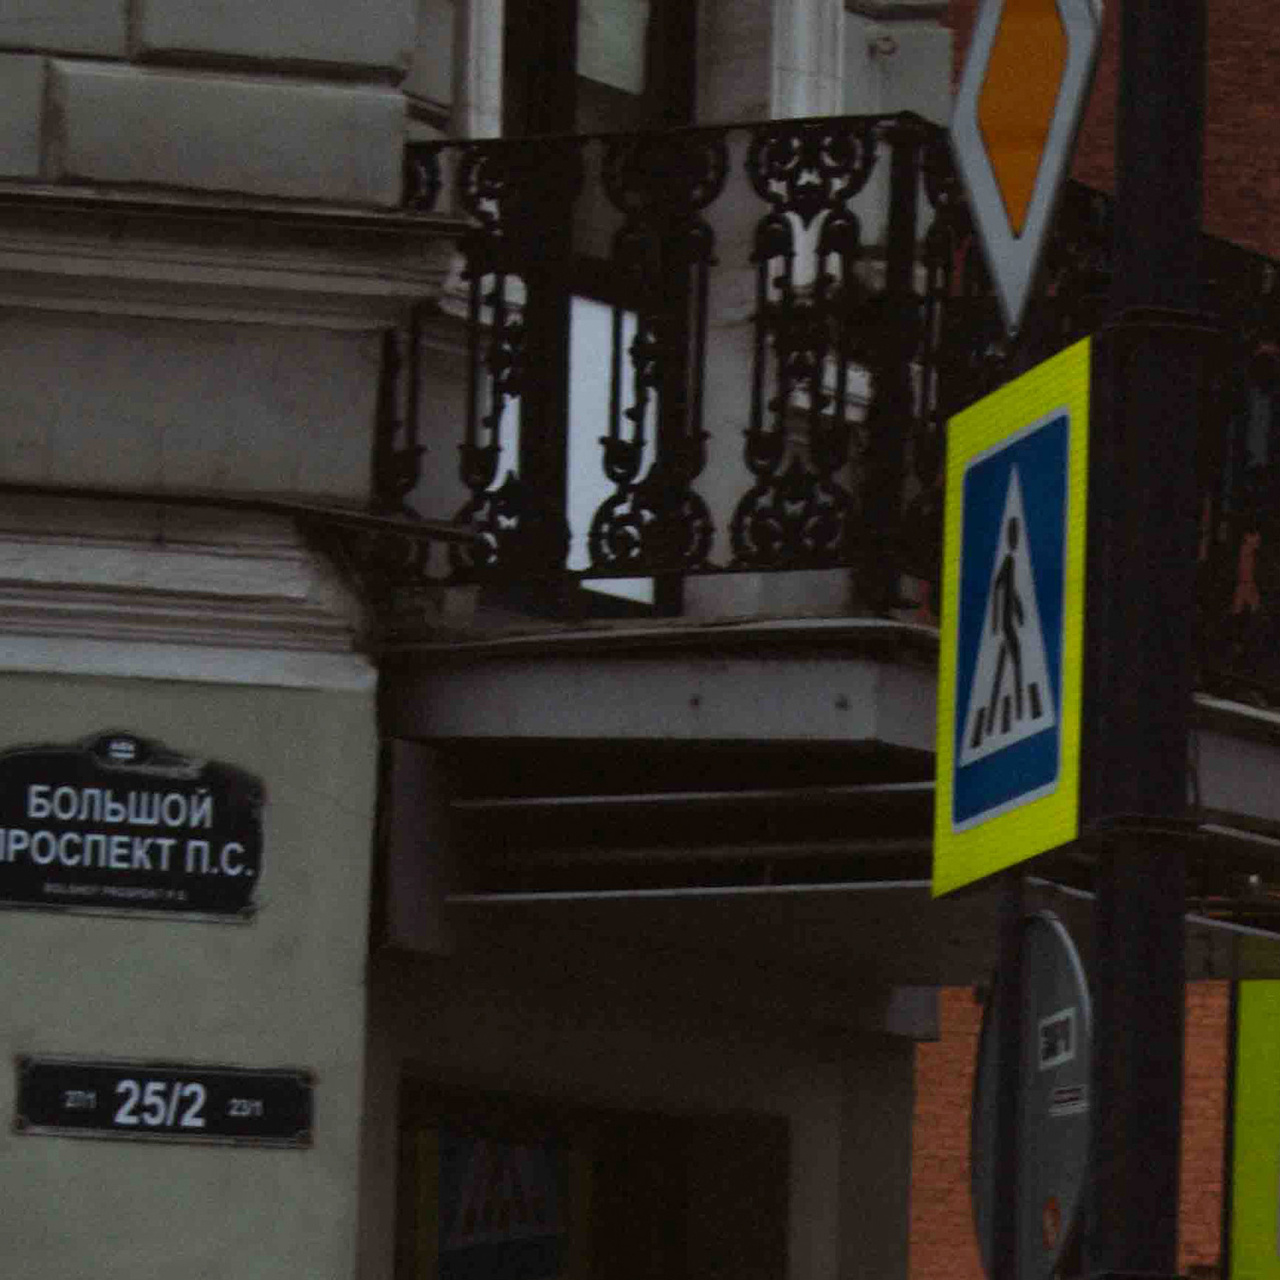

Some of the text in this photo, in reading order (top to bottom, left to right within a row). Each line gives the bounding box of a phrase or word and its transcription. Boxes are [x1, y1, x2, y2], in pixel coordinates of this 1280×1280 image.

[26, 783, 213, 829] БОЛЬШОЙ
[0, 829, 255, 877] РОСПЕКТ П.С.
[113, 1078, 206, 1127] 25/2
